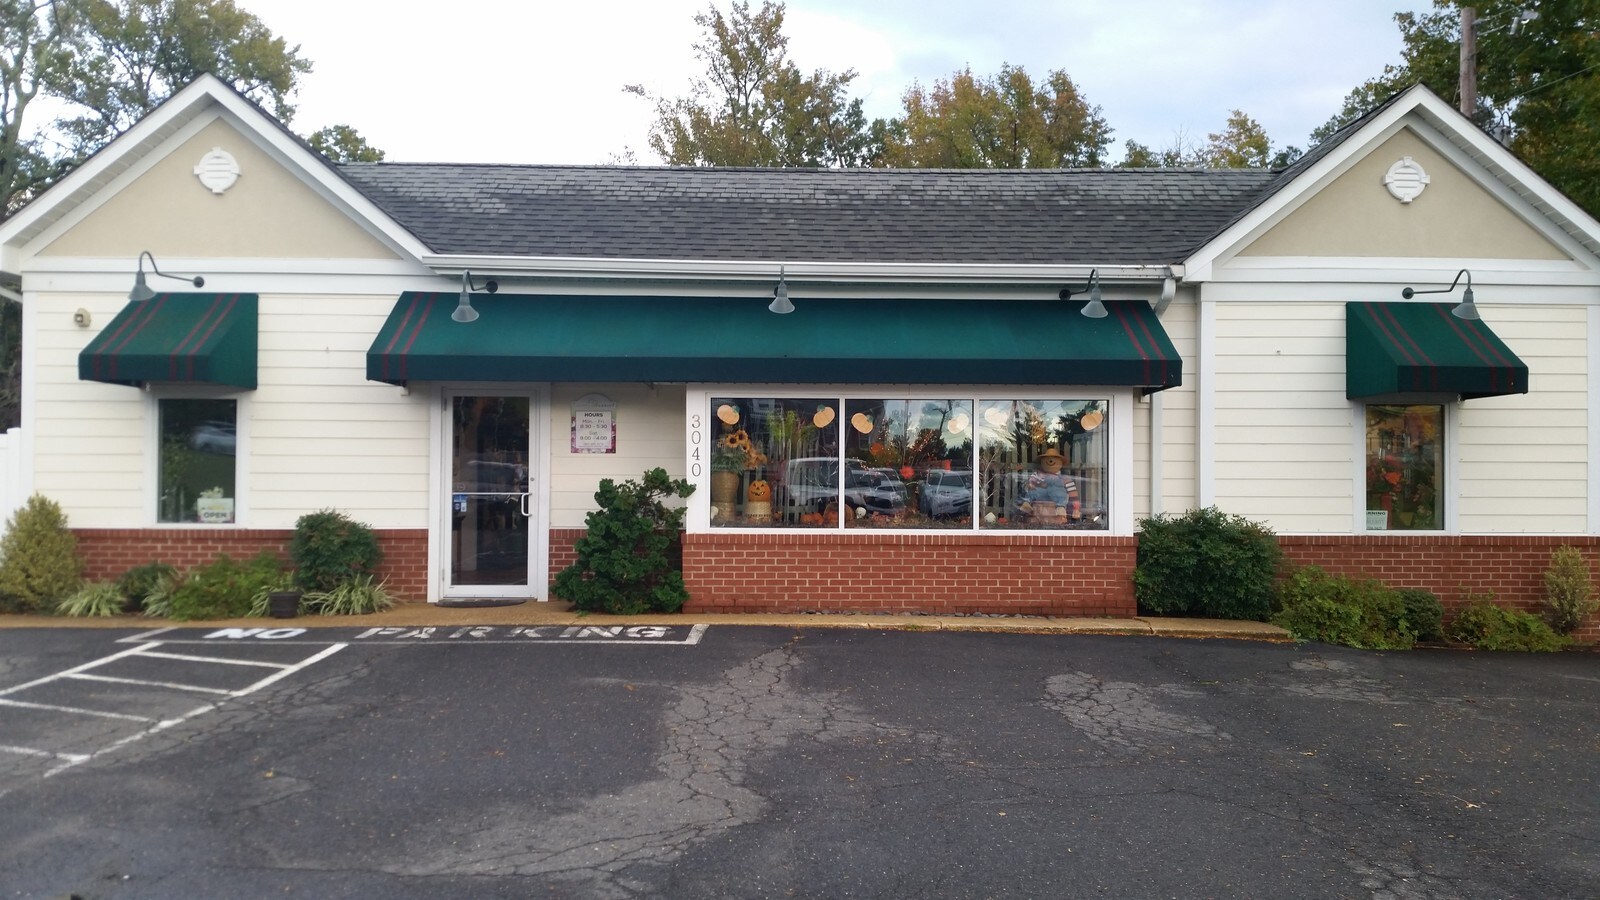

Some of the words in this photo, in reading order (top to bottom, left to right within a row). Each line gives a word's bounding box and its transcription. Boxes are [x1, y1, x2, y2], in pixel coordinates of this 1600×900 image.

[691, 414, 701, 477] 3040
[202, 628, 307, 639] NO
[354, 626, 676, 639] PARKING
